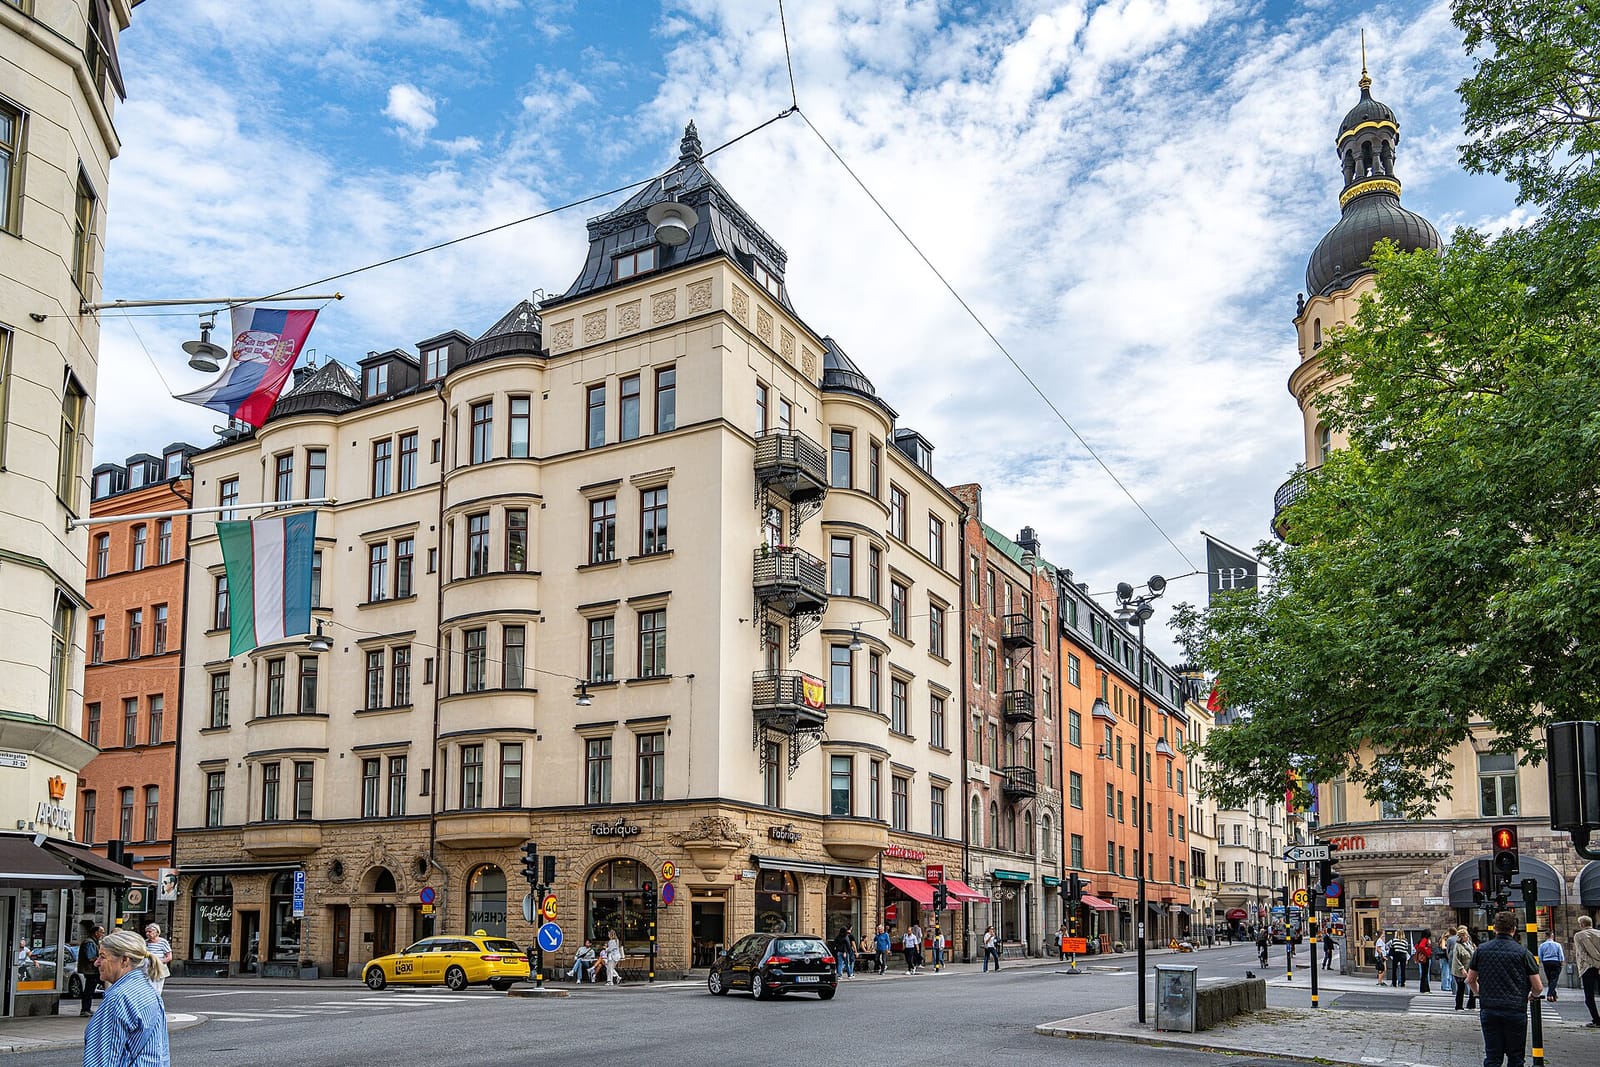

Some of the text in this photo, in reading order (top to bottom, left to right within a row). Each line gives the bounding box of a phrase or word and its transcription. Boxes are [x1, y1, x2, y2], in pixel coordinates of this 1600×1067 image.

[37, 802, 72, 830] APOTEK
[591, 822, 638, 838] Fabrique
[772, 826, 802, 843] Fabrique
[1299, 848, 1326, 859] Polis
[663, 866, 673, 876] 40
[296, 872, 304, 882] P
[1296, 893, 1309, 903] 30
[545, 901, 557, 913] 40
